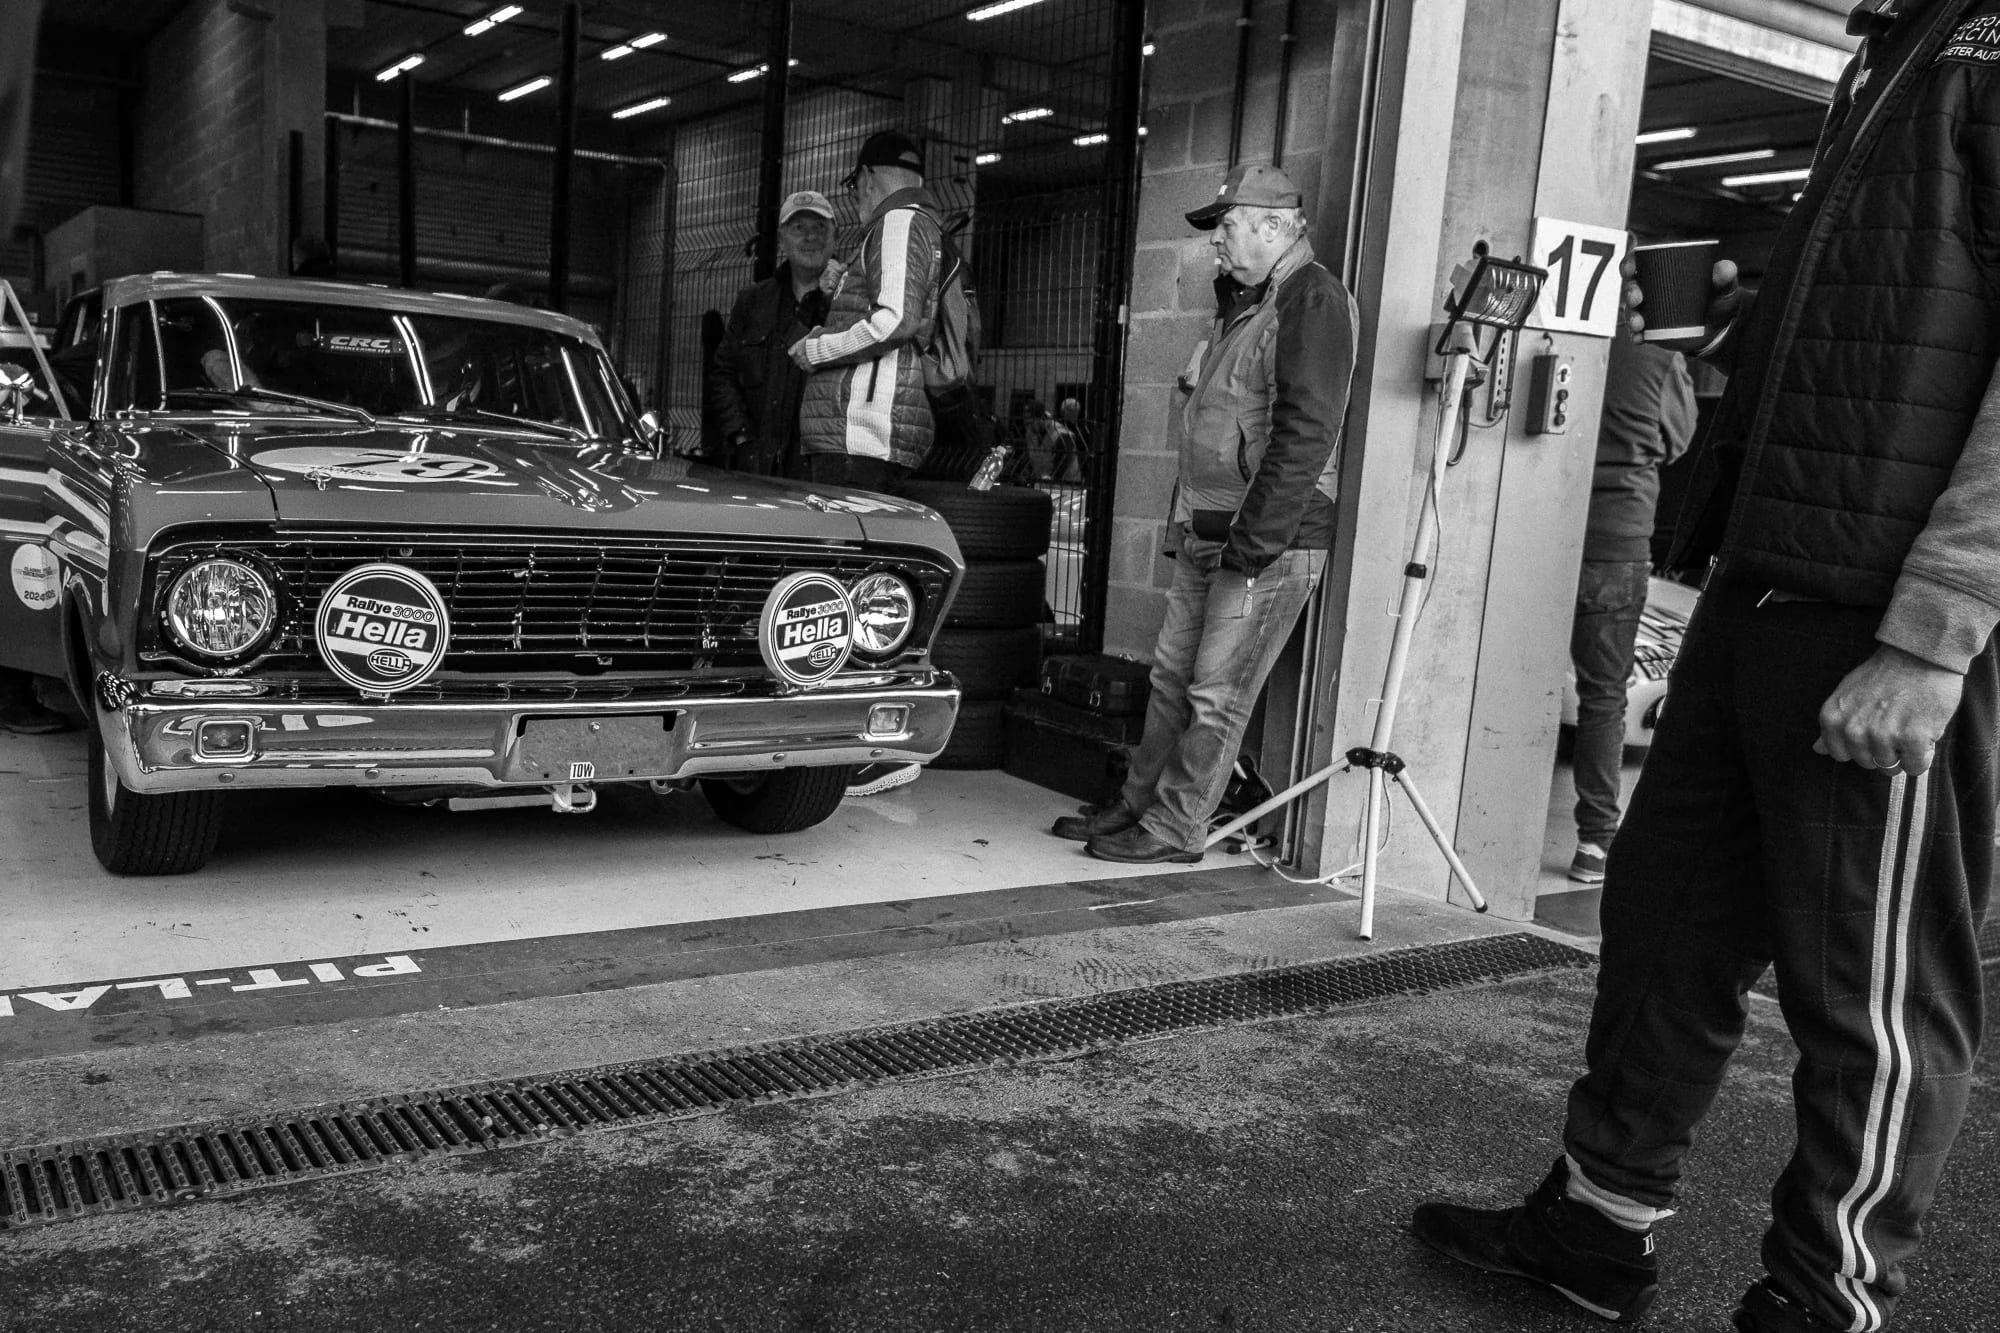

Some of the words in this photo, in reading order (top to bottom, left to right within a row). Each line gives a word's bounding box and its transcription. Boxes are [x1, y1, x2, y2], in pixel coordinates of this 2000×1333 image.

[1547, 234, 1615, 321] 17
[330, 336, 391, 349] CRC
[334, 452, 490, 478] 79
[346, 596, 392, 615] Rallye
[392, 605, 435, 622] 3000
[786, 607, 817, 621] Rallye
[817, 600, 845, 615] 3000
[335, 611, 427, 649] Hella
[783, 617, 842, 648] Hella
[370, 654, 412, 671] HELLA
[810, 646, 837, 661] HELLA
[572, 763, 593, 778] TOW
